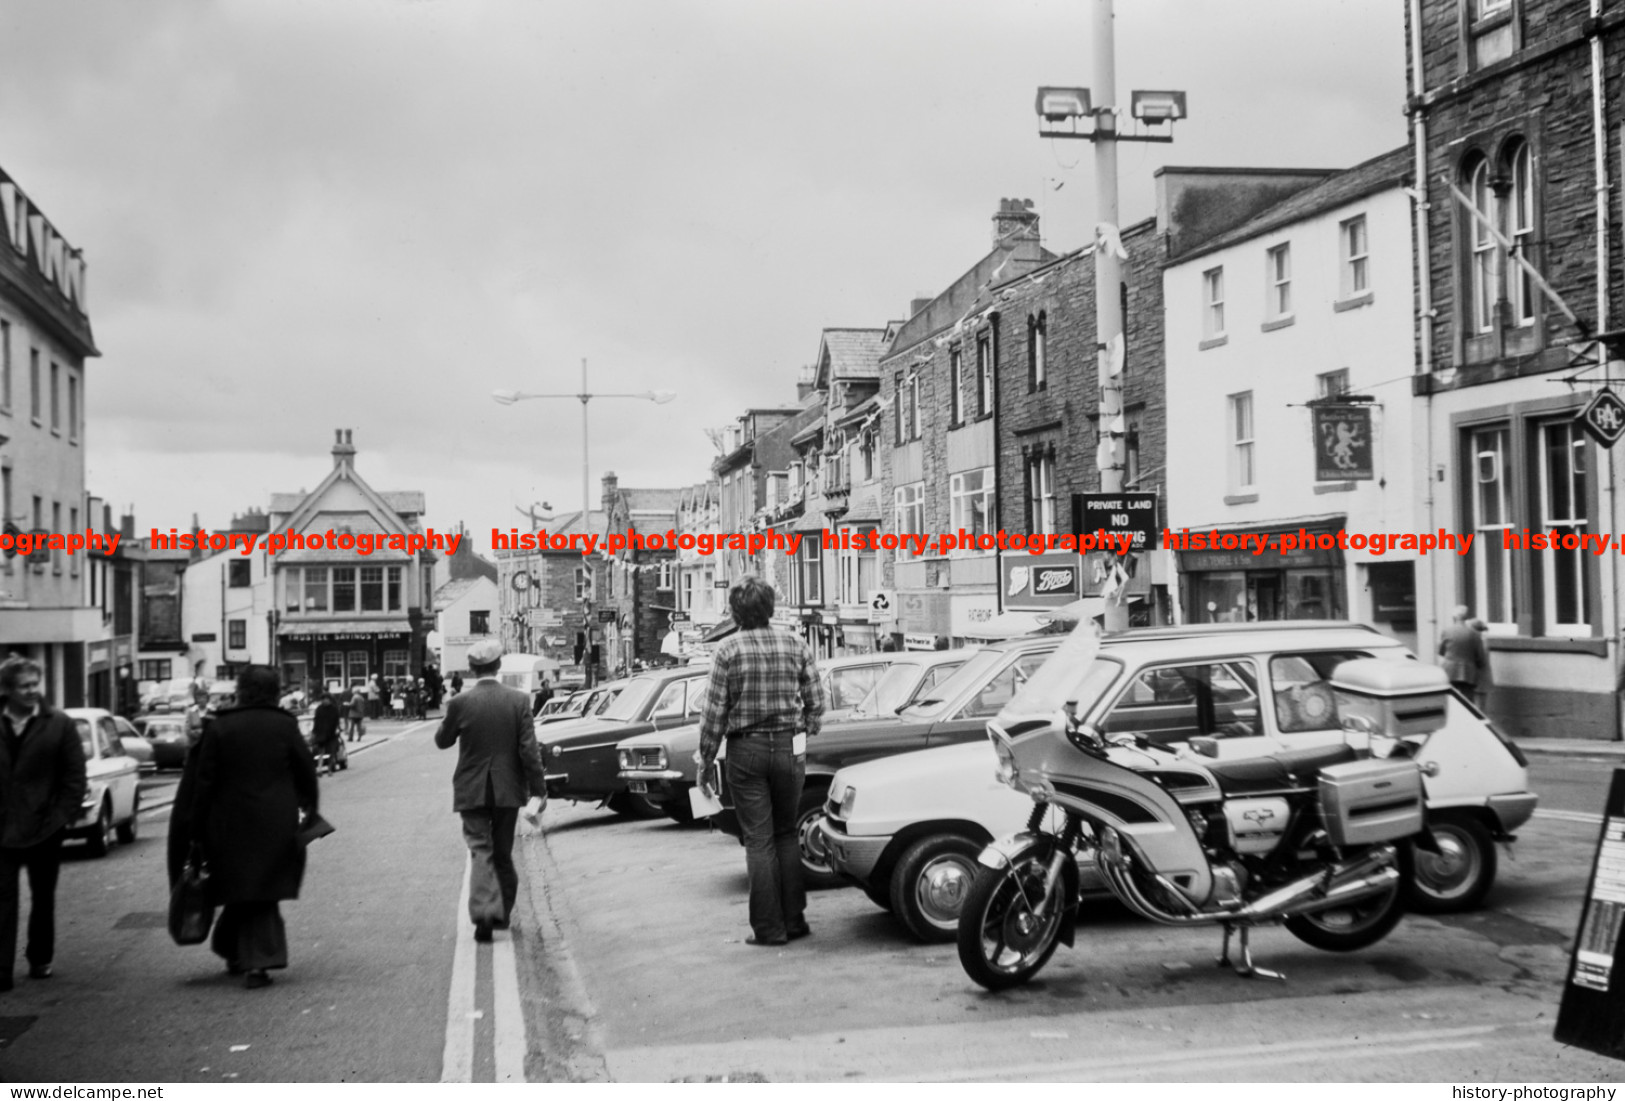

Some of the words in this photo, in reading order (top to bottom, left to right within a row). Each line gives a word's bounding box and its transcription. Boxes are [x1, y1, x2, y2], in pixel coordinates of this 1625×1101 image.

[1595, 403, 1623, 430] RAC
[1087, 500, 1123, 510] PRIVATE
[1127, 500, 1152, 510] LAND
[1111, 513, 1129, 527] NO
[1036, 570, 1072, 591] Boots
